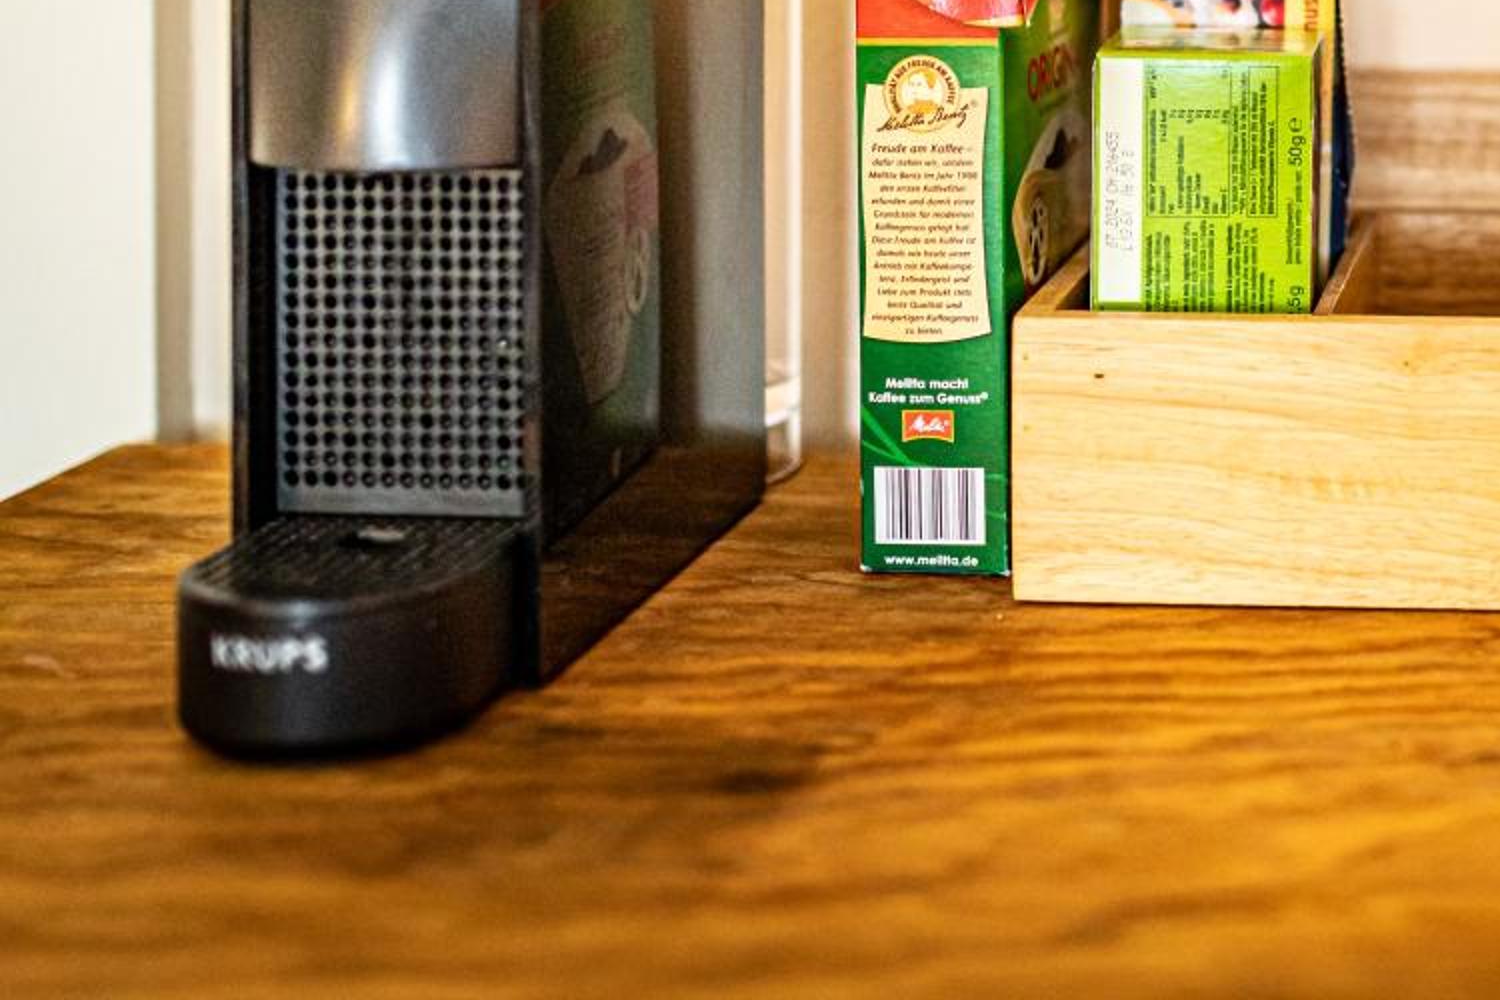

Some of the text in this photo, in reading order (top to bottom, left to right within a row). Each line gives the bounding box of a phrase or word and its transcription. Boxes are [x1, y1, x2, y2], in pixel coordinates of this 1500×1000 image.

[885, 377, 926, 389] Melitta
[868, 391, 906, 403] Kaffee
[884, 555, 979, 567] www.melitta.de
[210, 633, 329, 675] KRUPS
